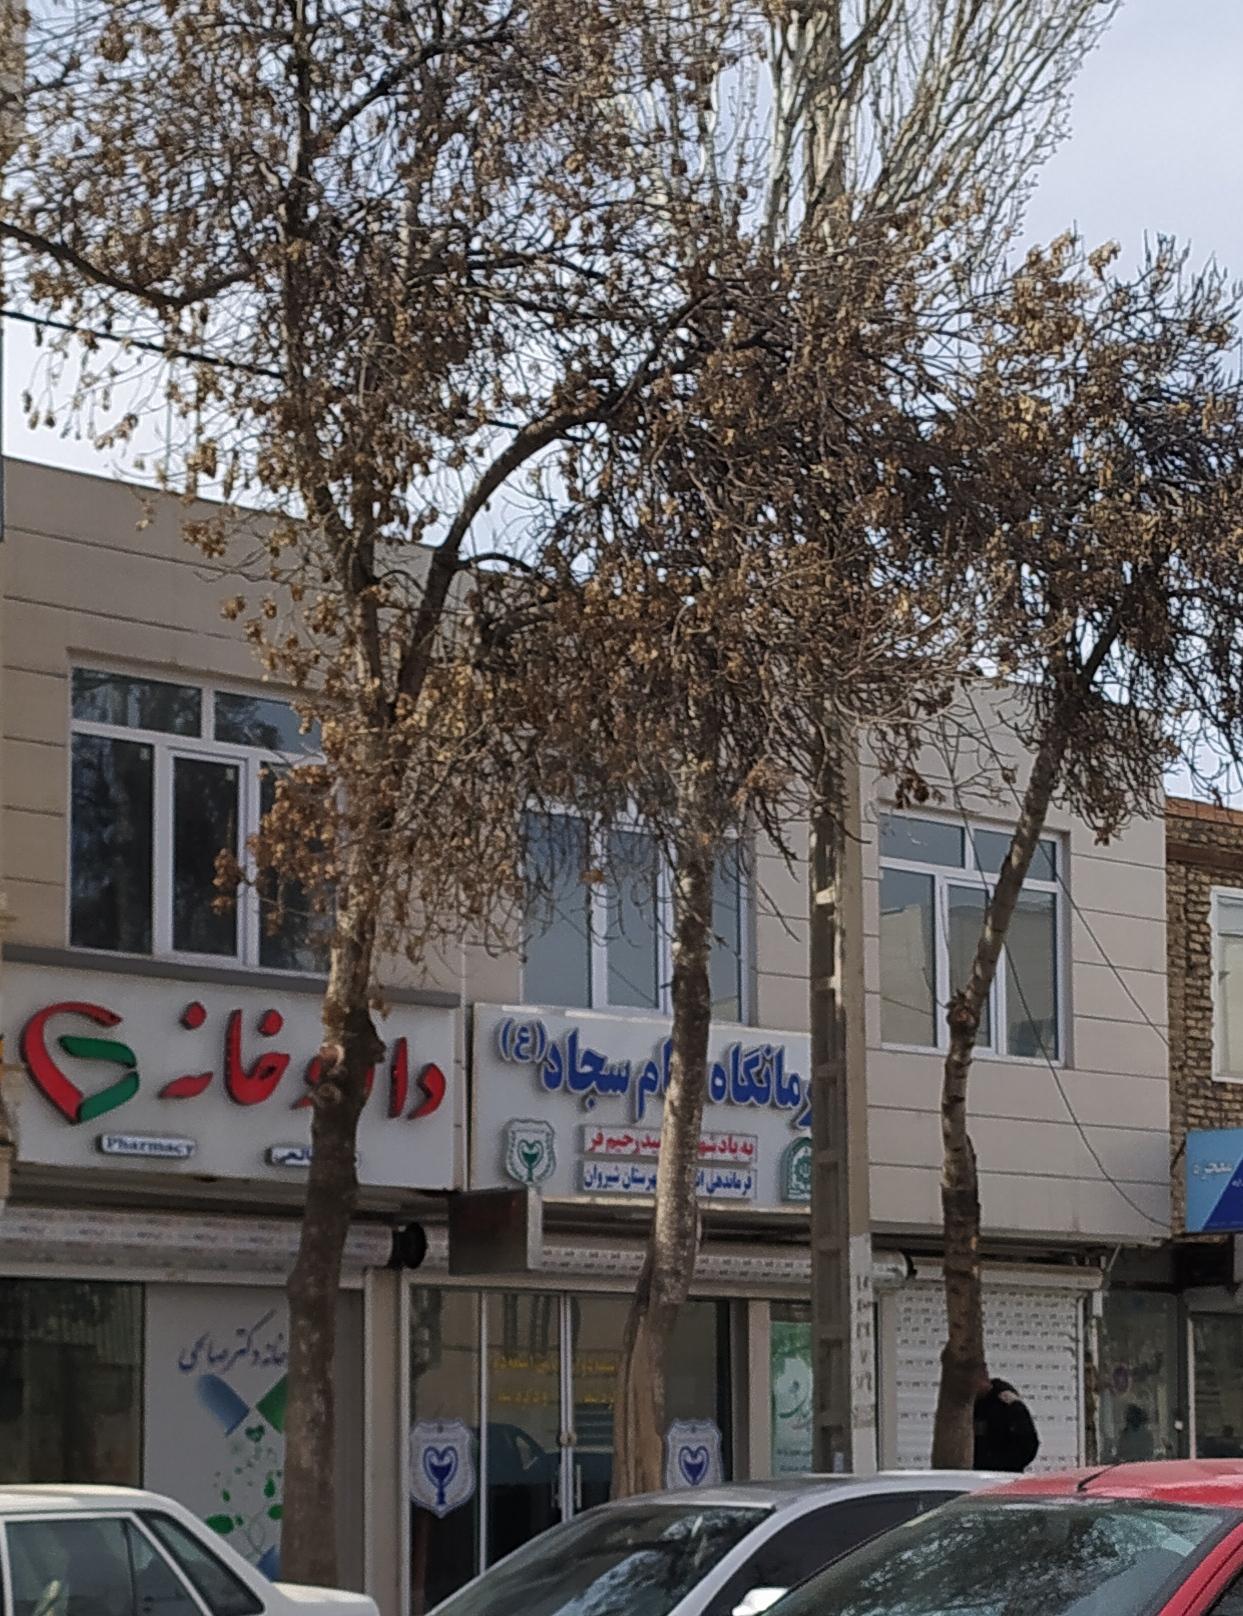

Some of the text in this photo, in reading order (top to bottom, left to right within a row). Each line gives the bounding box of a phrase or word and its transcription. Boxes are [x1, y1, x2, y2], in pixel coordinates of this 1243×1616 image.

[157, 1001, 447, 1121] داخانه
[500, 1018, 547, 1063] (ع)
[542, 1029, 630, 1110] سجاد
[107, 1137, 195, 1156] Pharmacy
